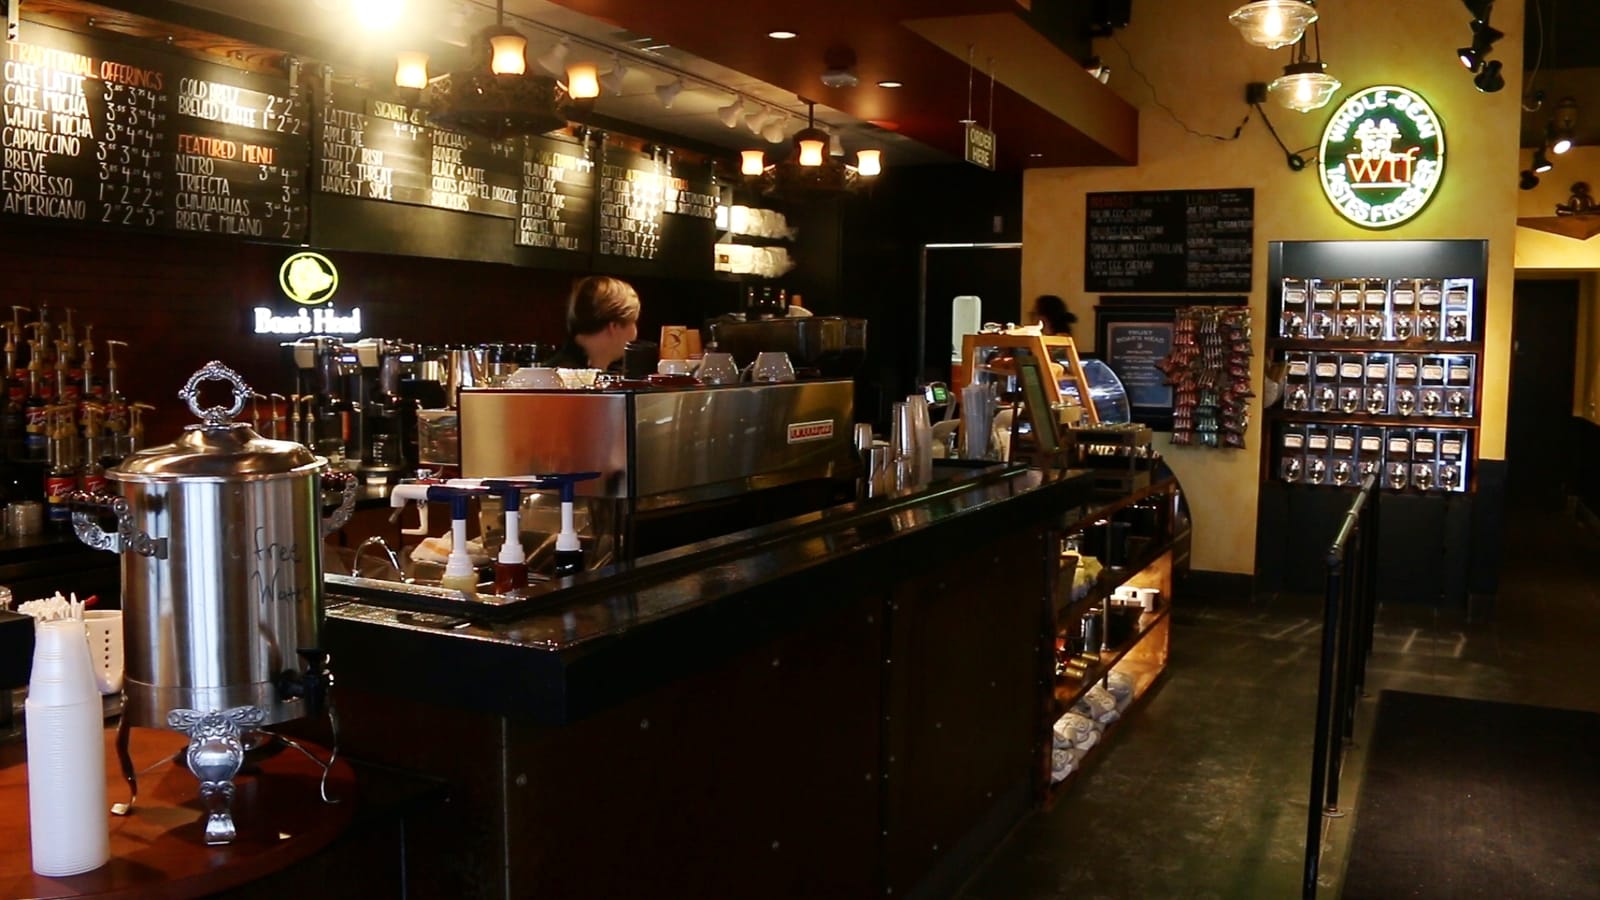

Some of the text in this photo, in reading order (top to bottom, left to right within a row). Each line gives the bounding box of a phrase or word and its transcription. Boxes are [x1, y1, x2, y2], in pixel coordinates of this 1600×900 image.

[4, 61, 40, 87] CAFE
[43, 68, 87, 96] LATTE
[101, 60, 163, 91] OFFERINGS
[4, 83, 39, 109] CAFE
[43, 90, 90, 118] MOCHA
[179, 77, 240, 105] COLD BREW
[178, 95, 219, 121] BREWED
[323, 107, 363, 131] LATTES
[1328, 90, 1437, 143] WHOLE-BEAN
[3, 105, 48, 131] WHITE
[52, 113, 94, 139] MOCHA
[2, 126, 80, 157] CAPPUCCINO
[177, 134, 237, 159] FEATURED
[242, 143, 274, 164] MENU
[323, 125, 365, 147] APPLE PIE
[433, 129, 468, 151] MOCHAS
[4, 148, 48, 174] BREVE
[175, 153, 214, 175] NITRO
[323, 142, 358, 164] NUTTY
[2, 170, 73, 197] ESPRESSO
[176, 172, 231, 197] TRIFECTA
[321, 158, 351, 178] TRIPLE
[356, 163, 395, 185] THREAT
[321, 176, 363, 196] HARVEST
[3, 193, 87, 220] AMERICANO
[176, 192, 250, 217] CHIHUAHUAS
[175, 210, 212, 232] BREVE
[219, 216, 263, 237] MILANO
[250, 567, 311, 605] Water
